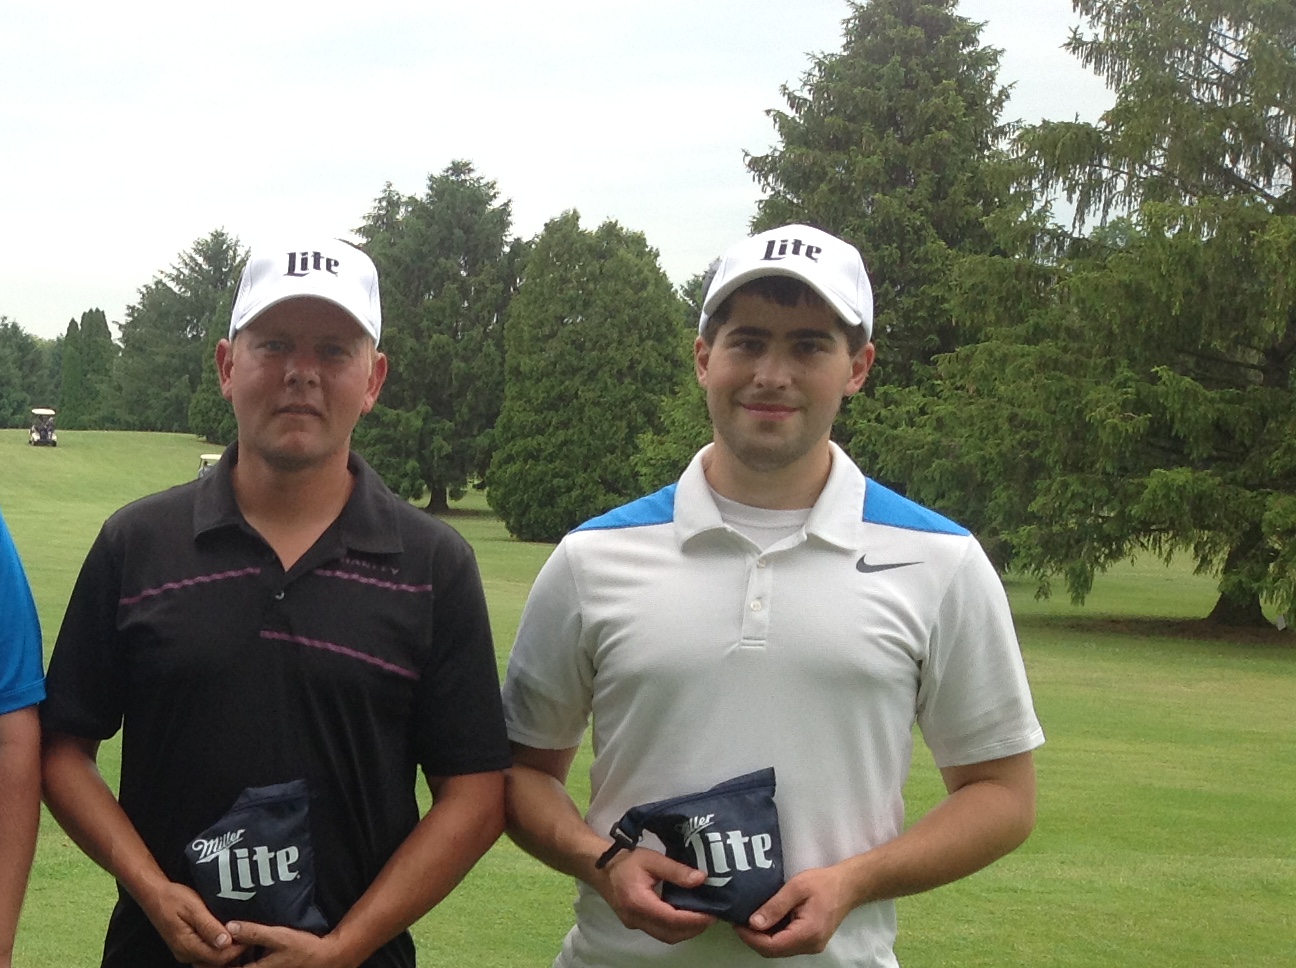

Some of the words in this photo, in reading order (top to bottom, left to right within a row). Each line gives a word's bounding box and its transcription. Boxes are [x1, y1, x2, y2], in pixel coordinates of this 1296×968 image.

[283, 251, 340, 277] Lite
[760, 239, 822, 263] Lite
[191, 829, 246, 860] Miller
[691, 830, 772, 887] Lite
[216, 846, 299, 901] Lite
